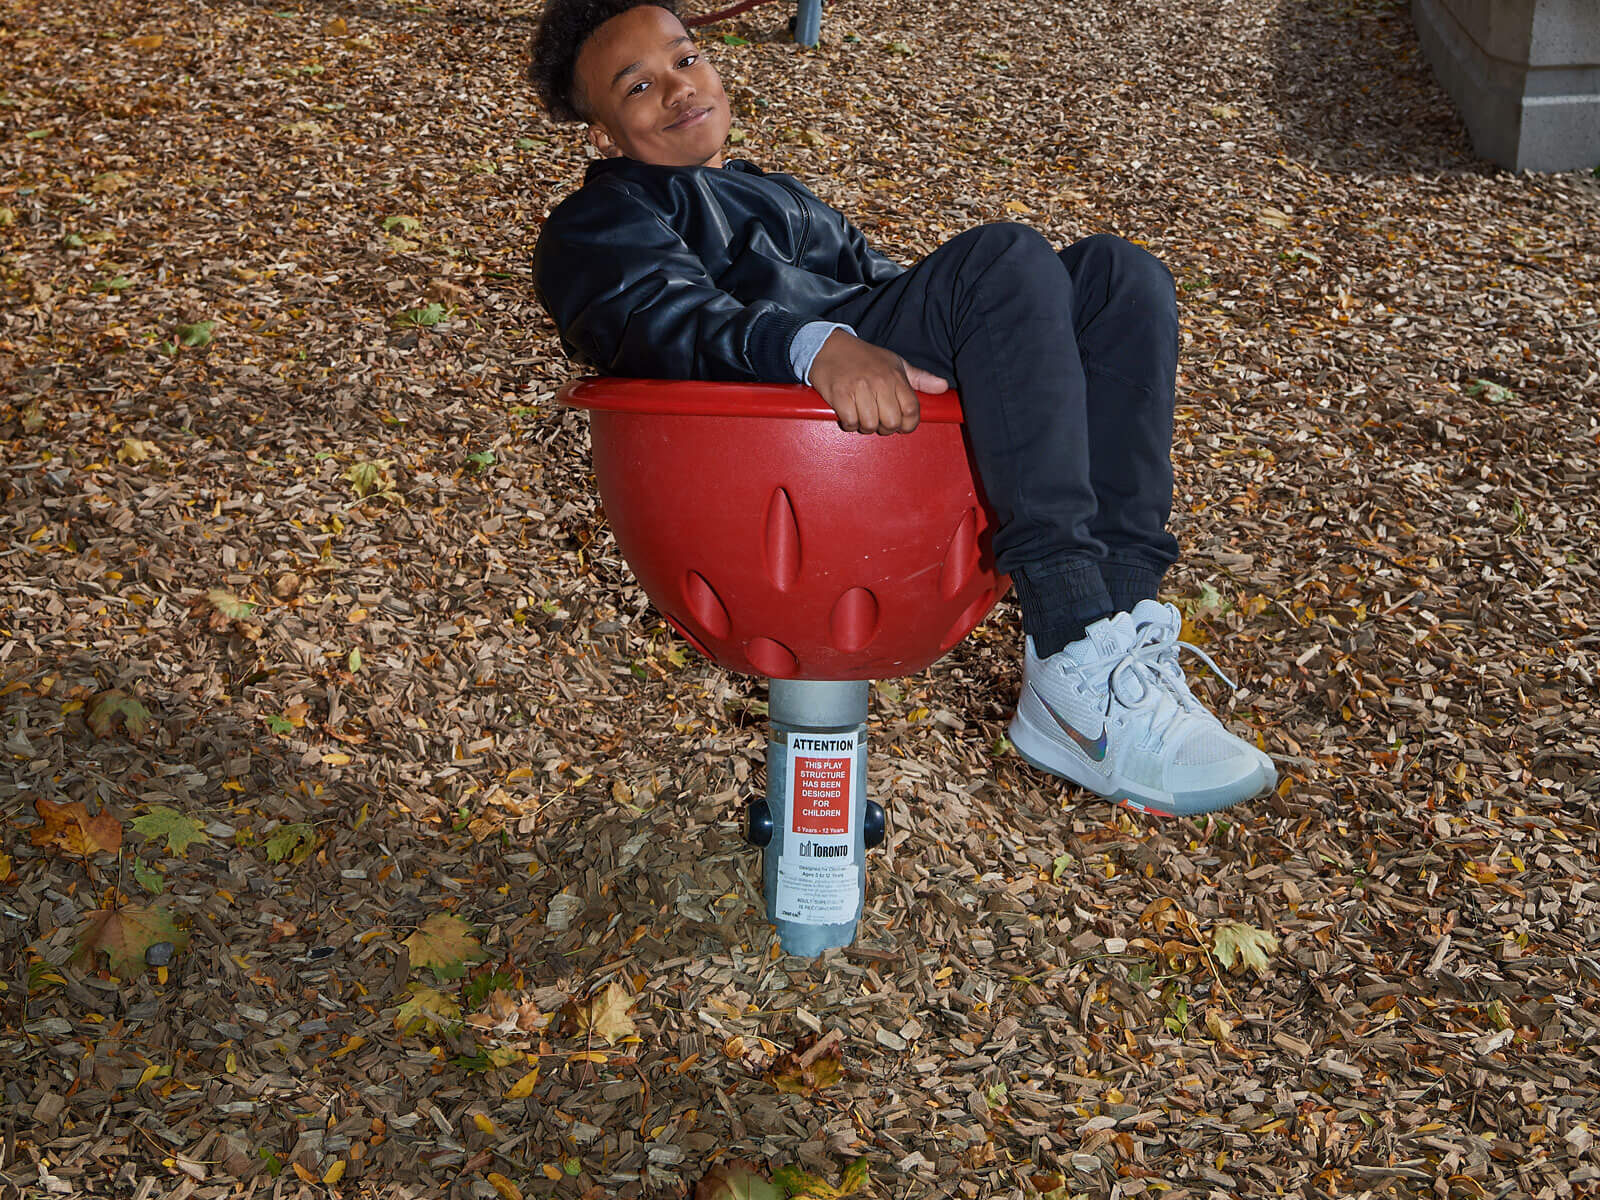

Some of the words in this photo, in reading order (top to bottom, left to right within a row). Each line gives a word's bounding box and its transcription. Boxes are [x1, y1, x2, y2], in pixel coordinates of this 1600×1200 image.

[793, 738, 854, 751] ATTENTION
[805, 761, 822, 769] THIS
[824, 761, 843, 769] PLAY
[800, 771, 846, 779] STRUCTURE
[802, 780, 819, 788] HAS
[820, 780, 841, 788] BEEN
[802, 790, 841, 798] DESIGNED
[802, 809, 841, 817] CHILDREN
[813, 843, 848, 857] TORONTO
